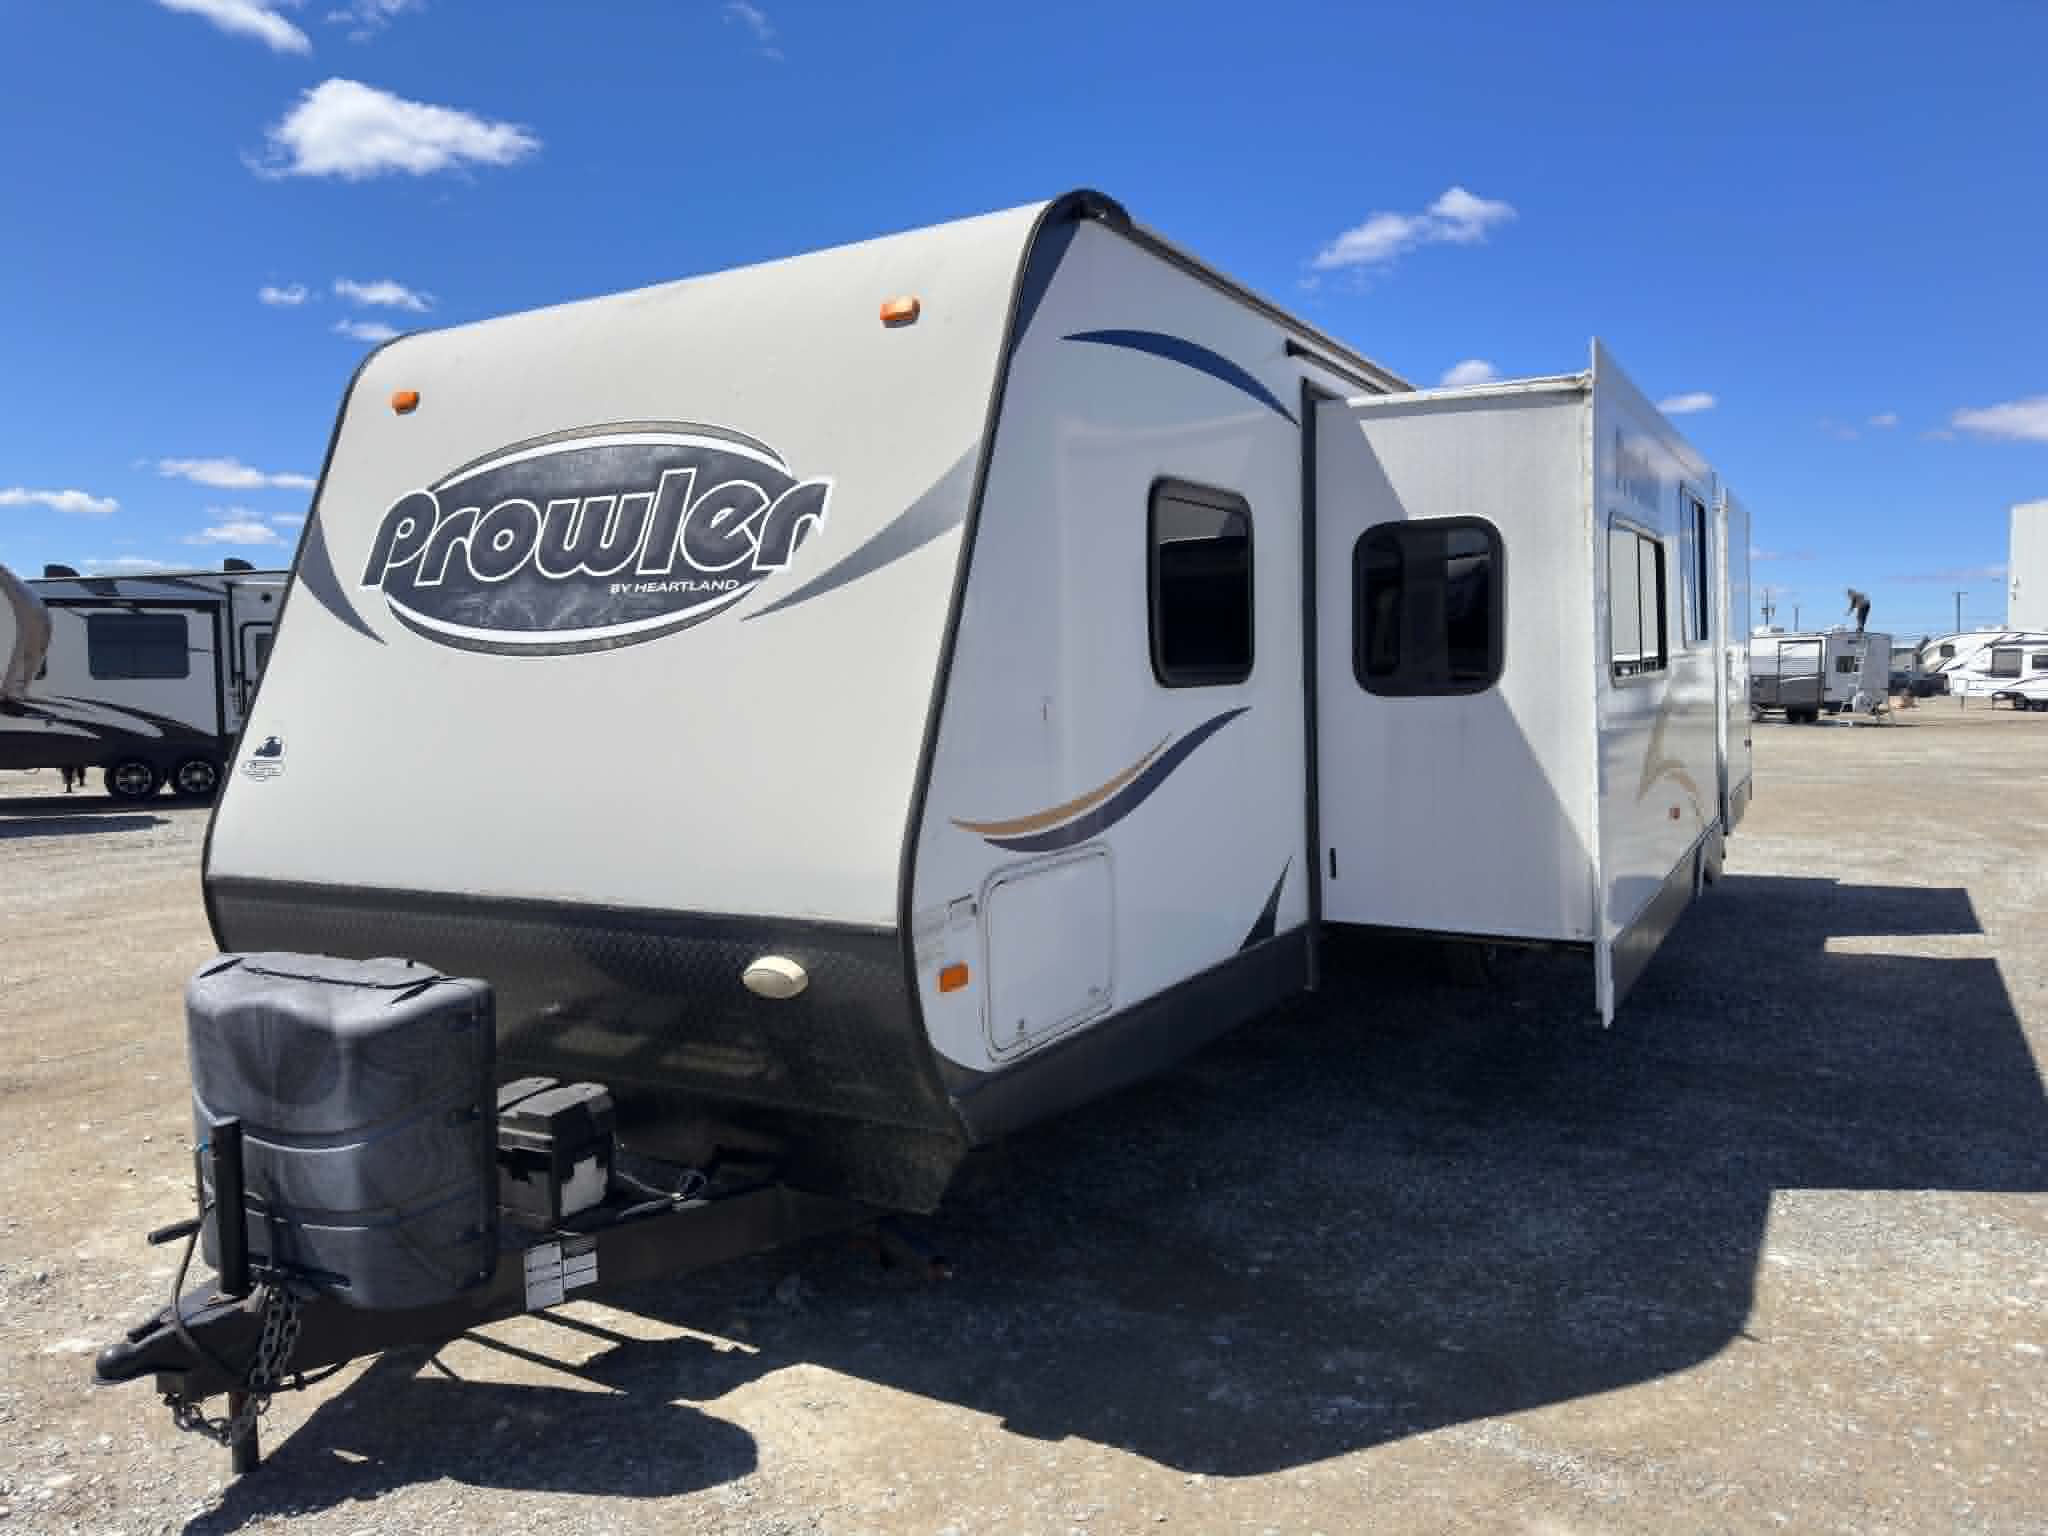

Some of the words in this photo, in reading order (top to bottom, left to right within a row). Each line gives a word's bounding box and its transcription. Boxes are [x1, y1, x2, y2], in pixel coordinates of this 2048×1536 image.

[360, 468, 831, 590] Prowler
[610, 583, 632, 593] BY
[634, 579, 740, 593] HEARTLAND
